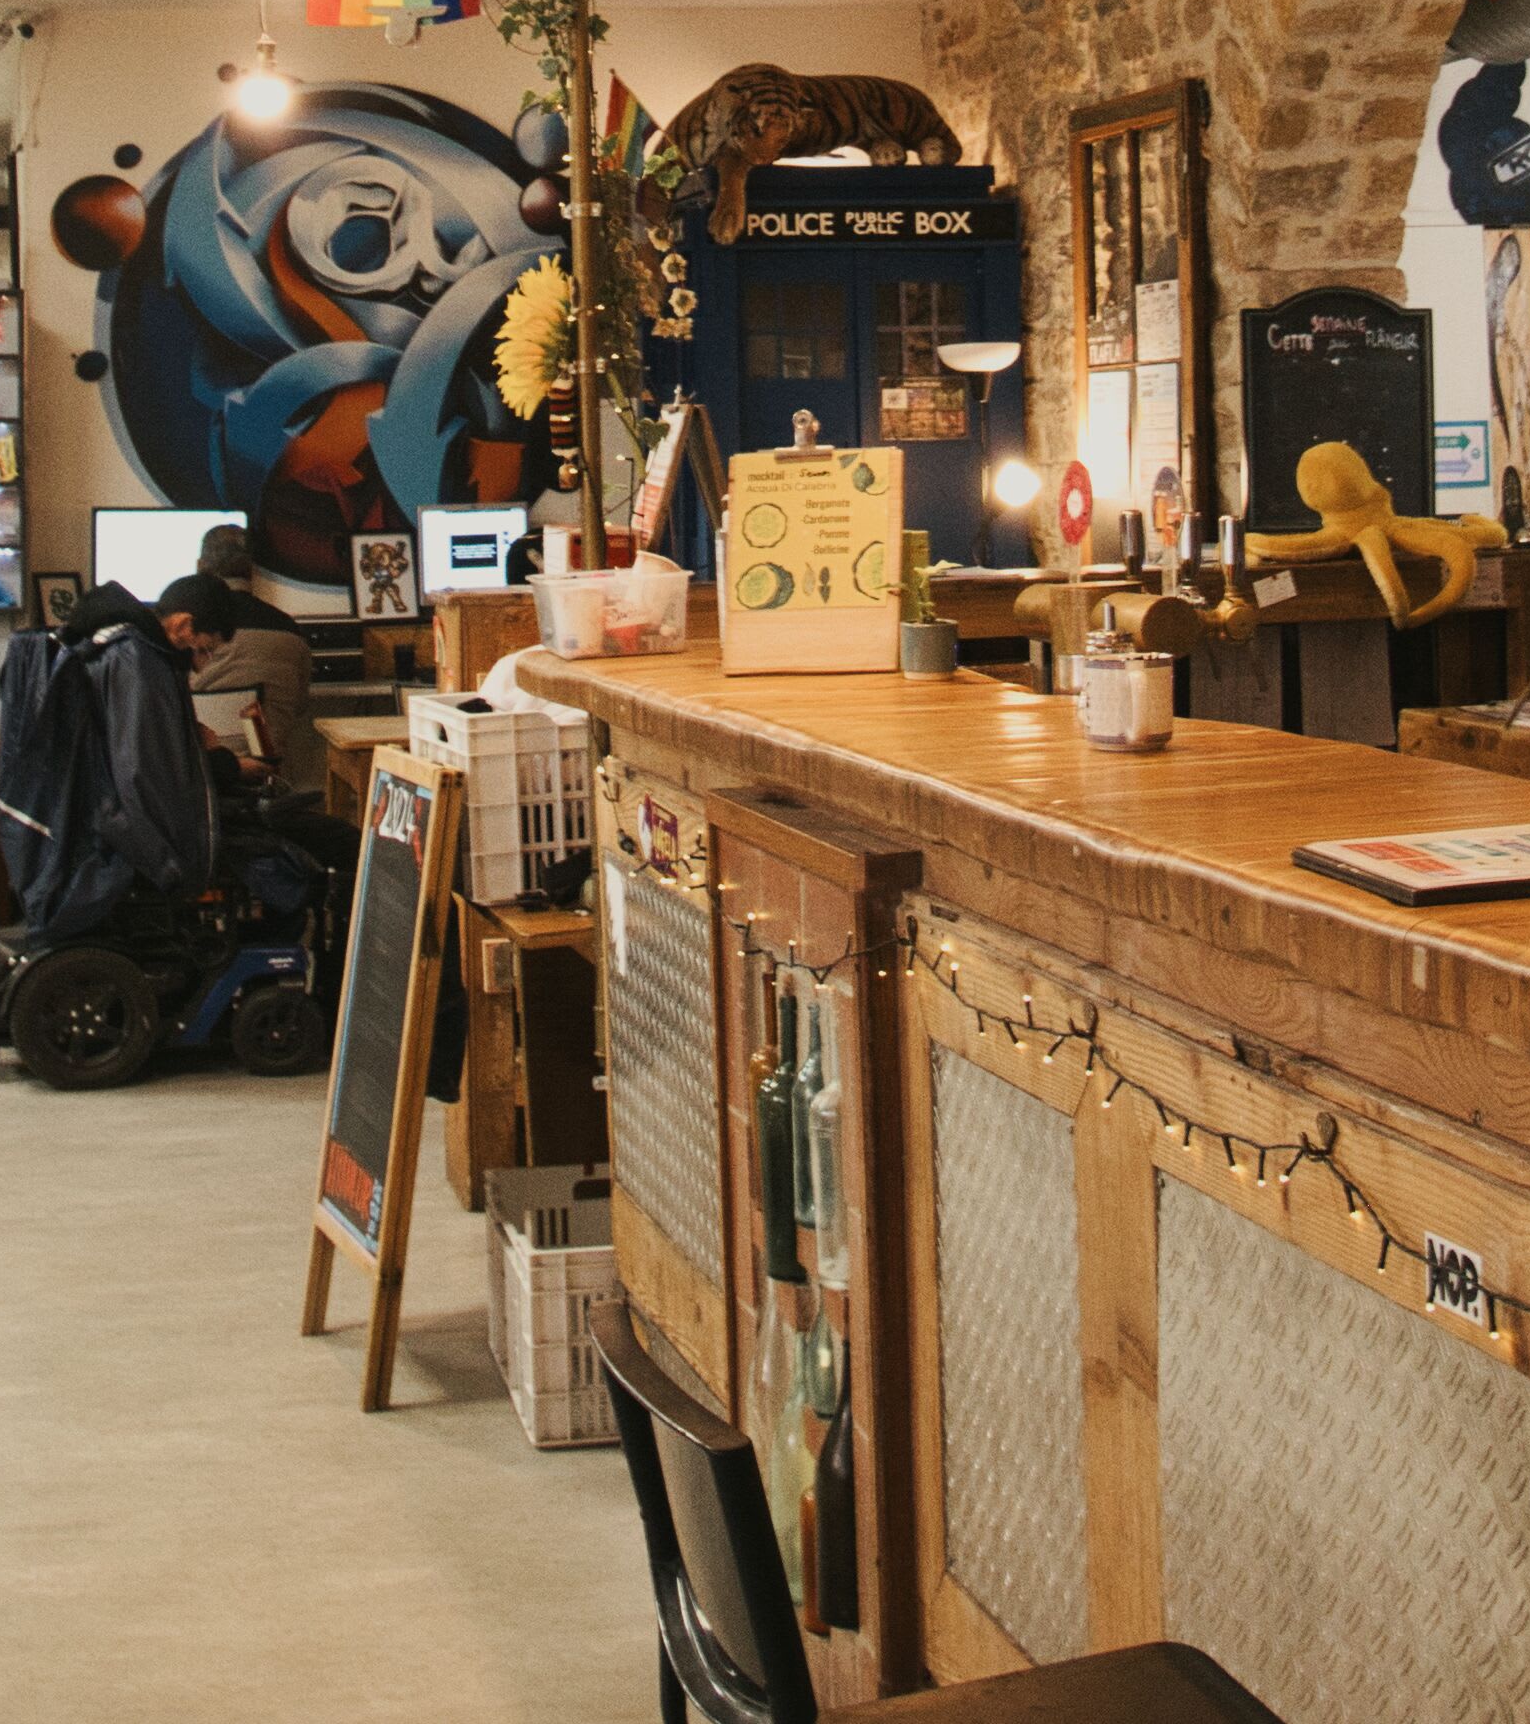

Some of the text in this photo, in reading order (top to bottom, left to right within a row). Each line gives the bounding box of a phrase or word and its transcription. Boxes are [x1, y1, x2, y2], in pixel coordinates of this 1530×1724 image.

[747, 211, 973, 237] POLICE PUBLIC CALL BOX
[747, 470, 785, 482] mocktail
[746, 484, 778, 493] Acqua
[795, 482, 837, 492] Calabria
